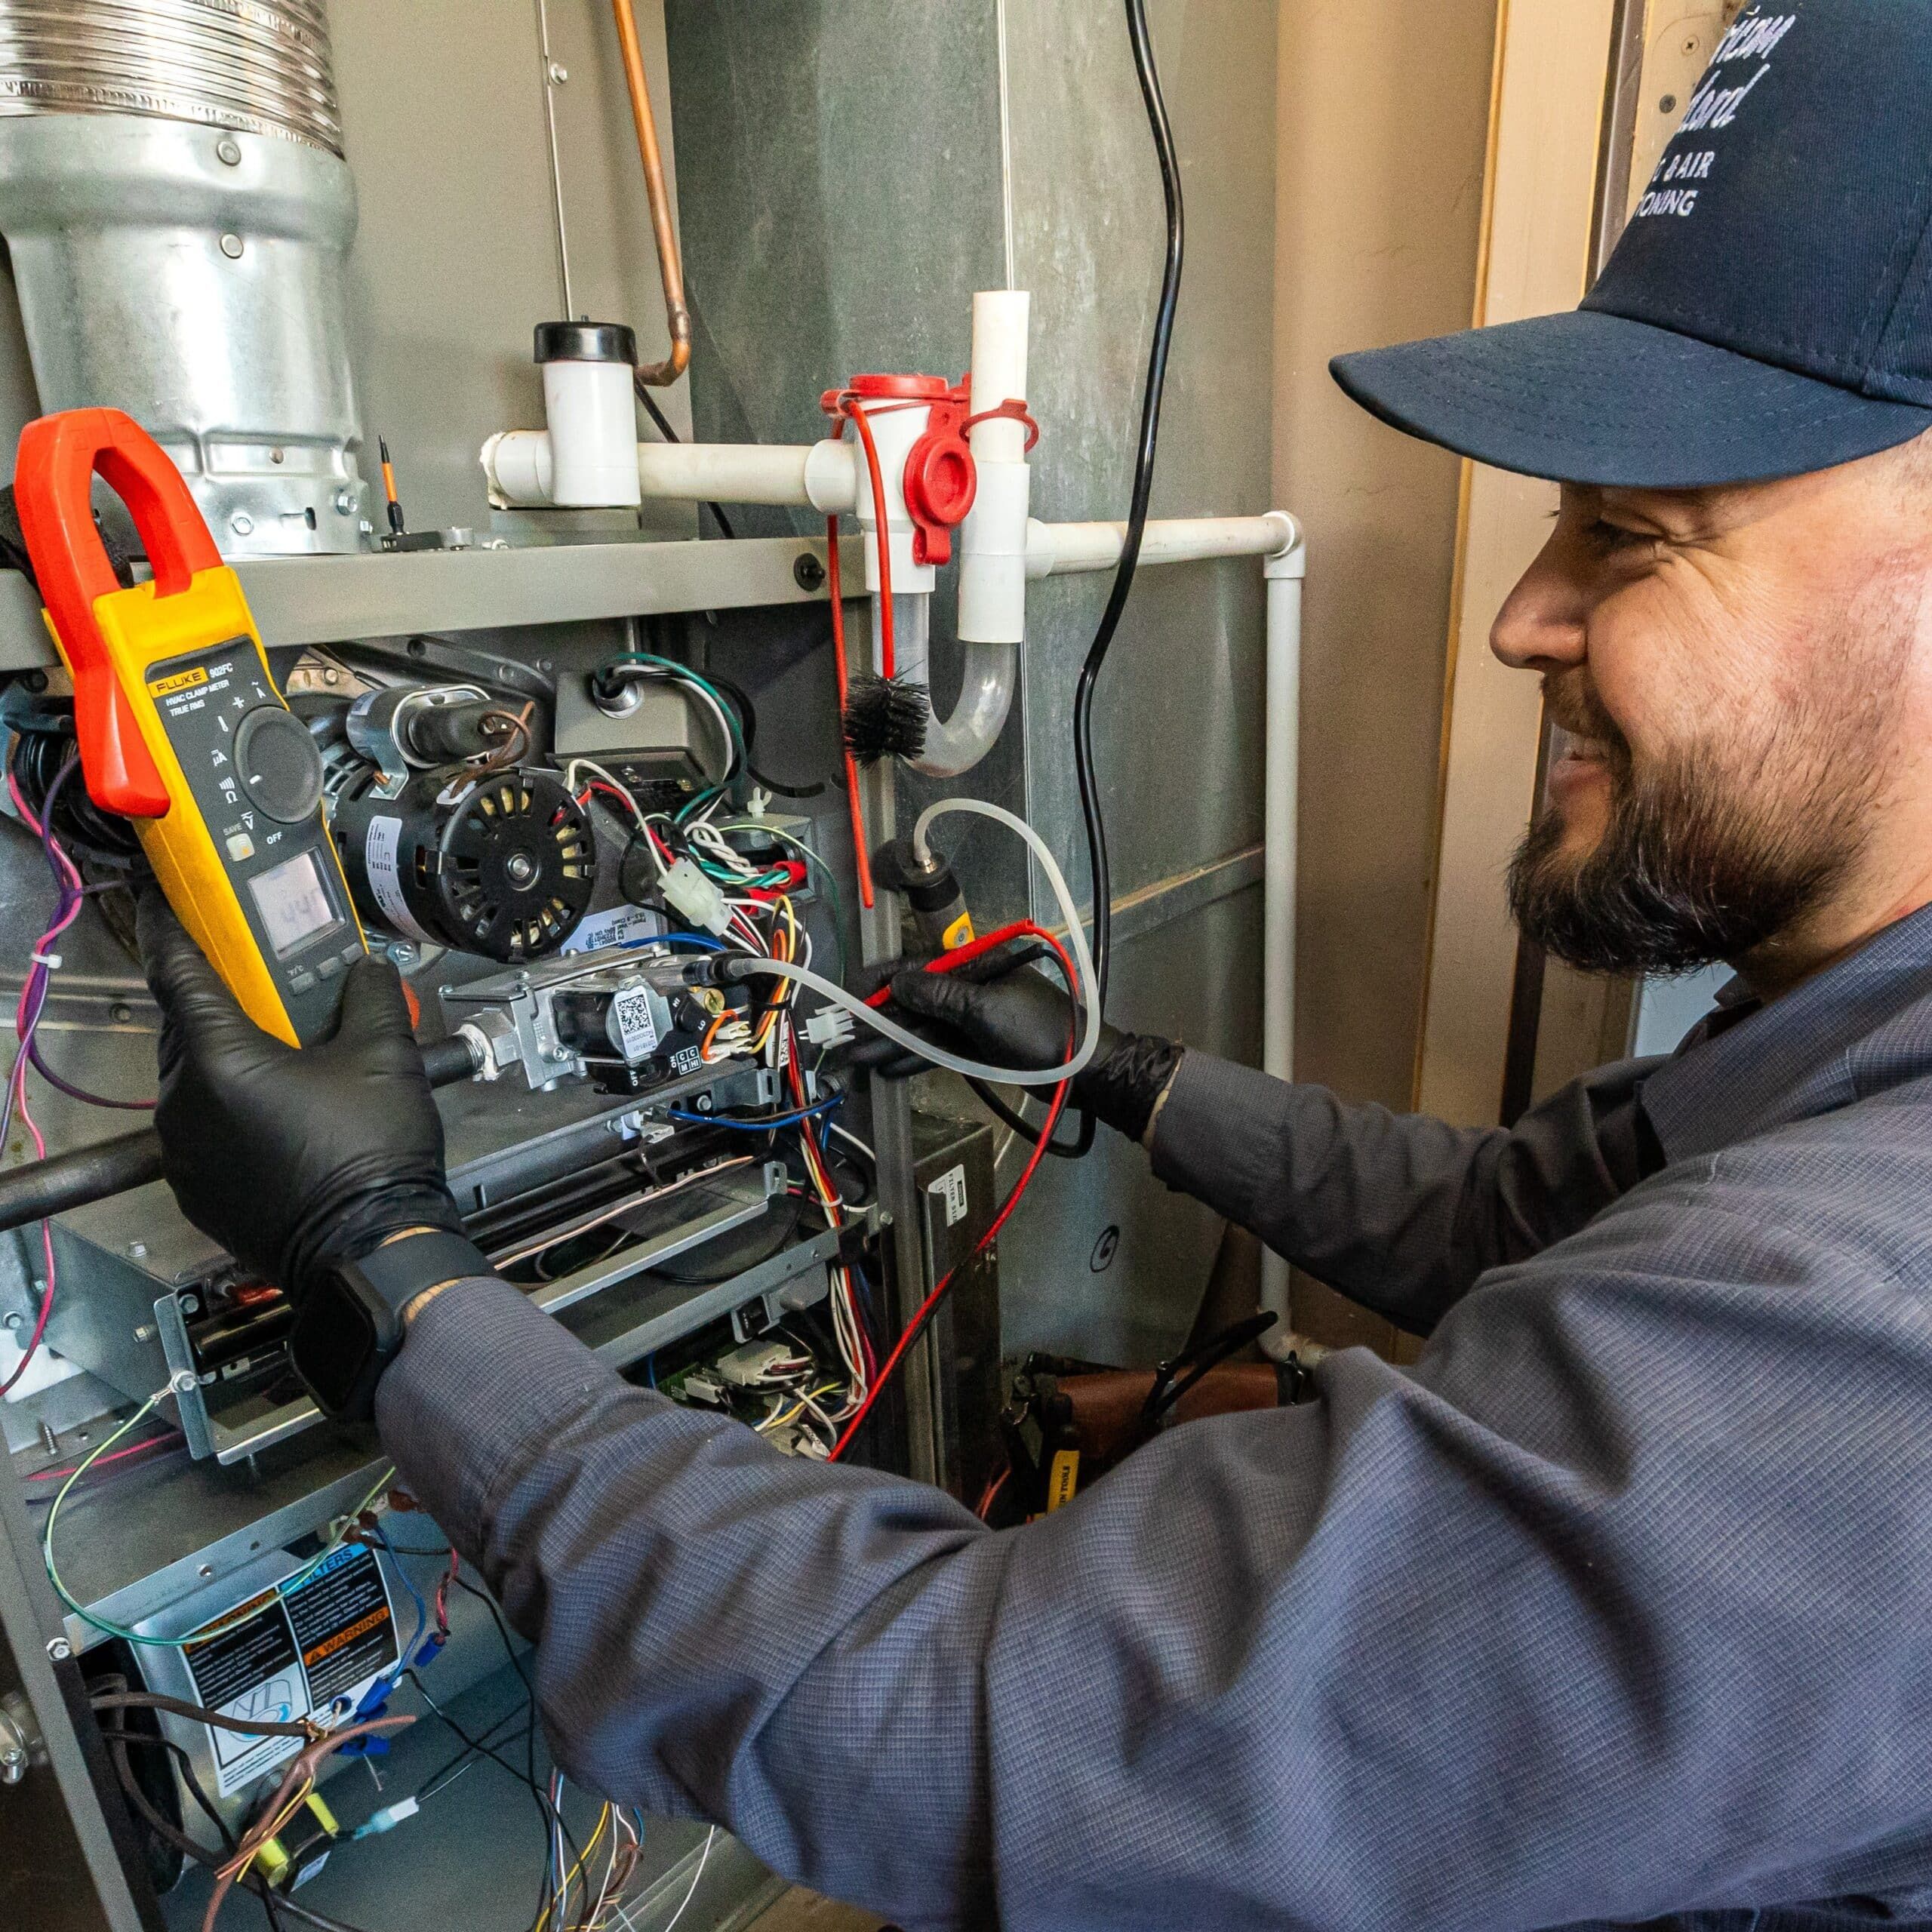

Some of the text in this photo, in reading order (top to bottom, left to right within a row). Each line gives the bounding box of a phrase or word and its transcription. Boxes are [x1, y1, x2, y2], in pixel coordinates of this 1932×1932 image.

[1675, 151, 1715, 179] AIR
[156, 663, 233, 693] FLUKE 902FC
[166, 679, 229, 706] HVAC CLAMP METER
[169, 699, 205, 717] TRUE RMS
[223, 823, 242, 835] SAVE
[266, 831, 283, 844] OFF
[672, 997, 681, 1008] HI
[697, 1020, 706, 1031] LO
[669, 1055, 677, 1069] ON
[679, 1053, 685, 1061] C
[691, 1059, 699, 1069] HI
[629, 1069, 638, 1087] OFF
[323, 1611, 386, 1653] WARNING
